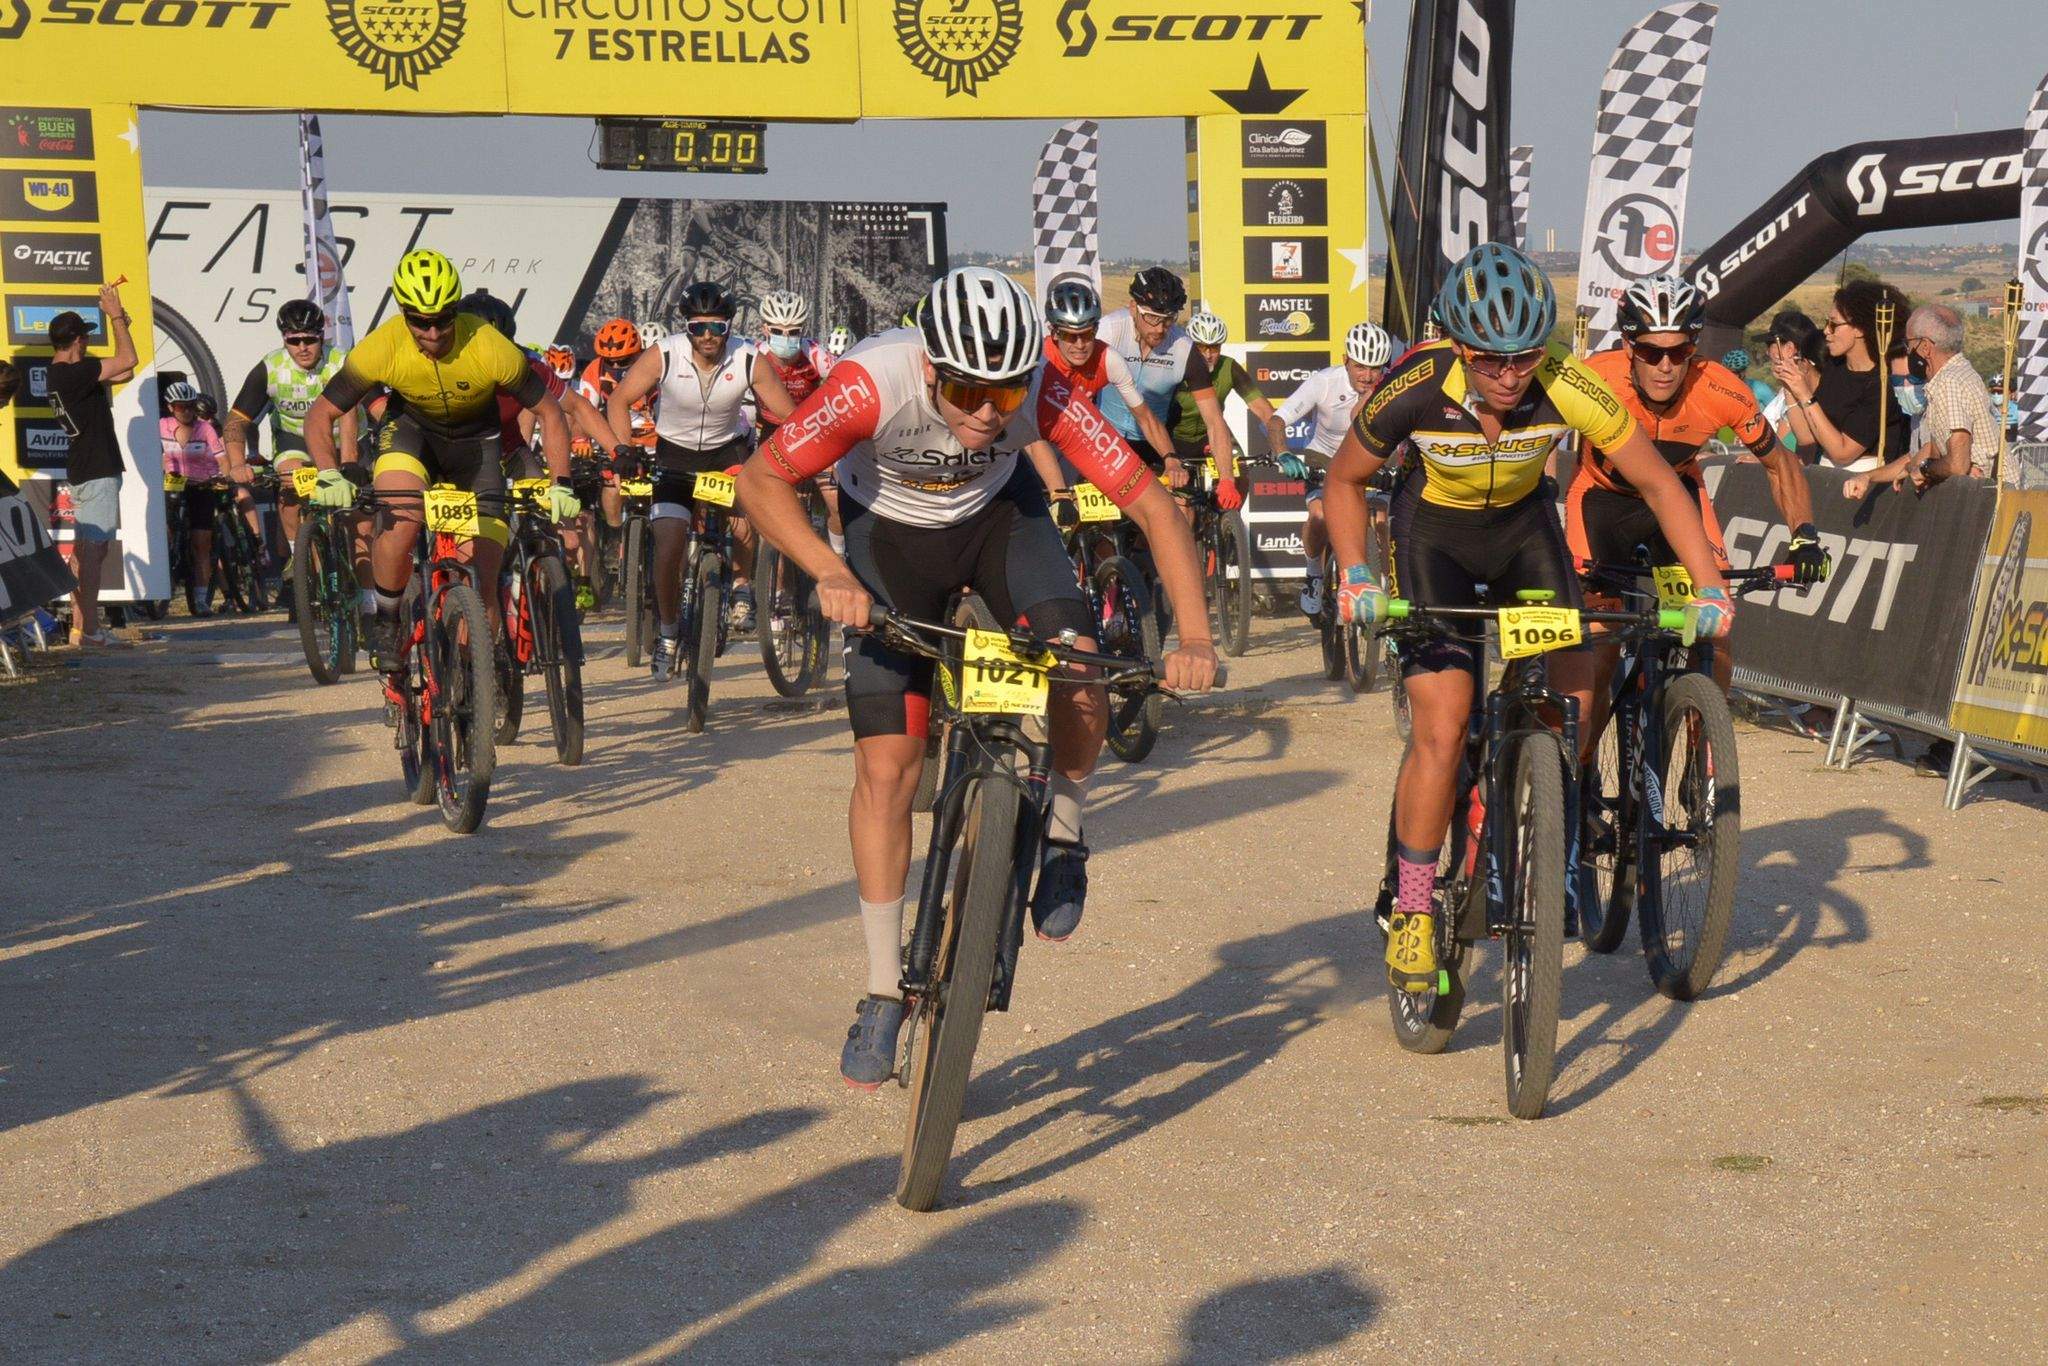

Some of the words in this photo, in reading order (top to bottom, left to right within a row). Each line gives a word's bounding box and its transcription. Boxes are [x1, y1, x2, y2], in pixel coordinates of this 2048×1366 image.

[40, 0, 291, 29] SCOTT
[360, 5, 435, 16] SCOTT
[925, 14, 993, 25] SCOTT
[1104, 14, 1323, 41] SCOTT
[554, 28, 576, 60] 7
[588, 28, 811, 64] ESTRELLAS
[38, 122, 75, 132] BUEN
[28, 182, 70, 197] WD-40
[1719, 192, 1810, 279] SCOTT
[33, 250, 92, 265] TACTIC
[1259, 299, 1312, 311] AMSTEL
[1545, 357, 1620, 417] X-SAUCE
[701, 476, 733, 494] 1011
[431, 503, 474, 520] 1089
[1257, 533, 1304, 548] Lamb
[1508, 628, 1575, 645] 1096
